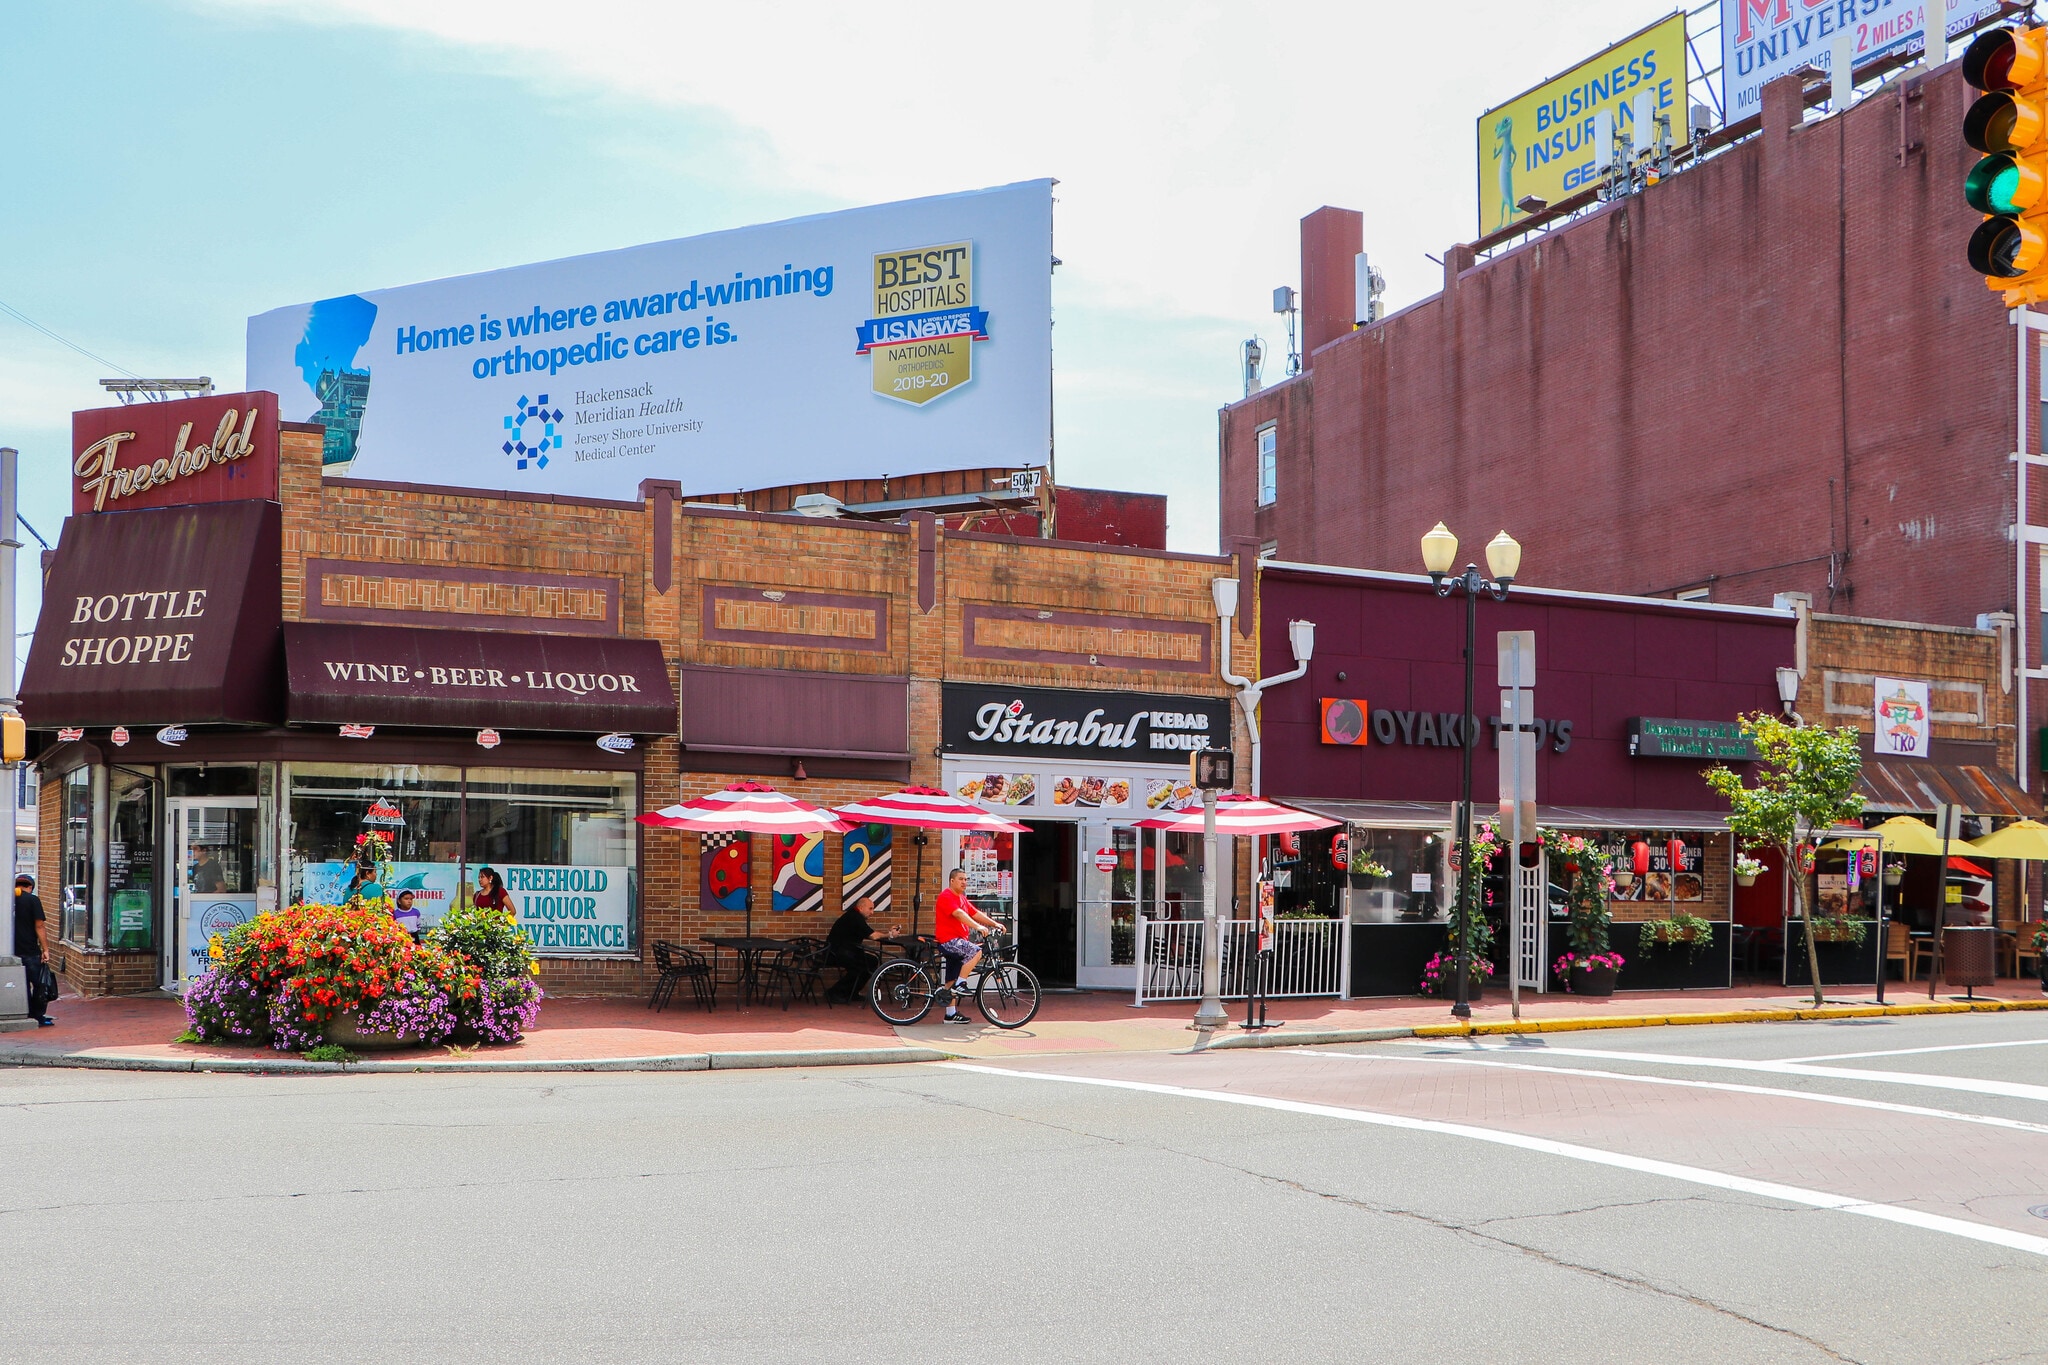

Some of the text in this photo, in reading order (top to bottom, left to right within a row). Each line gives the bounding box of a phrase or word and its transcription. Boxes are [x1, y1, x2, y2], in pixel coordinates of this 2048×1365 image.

[1857, 23, 1868, 53] 2
[1873, 11, 1913, 46] MILES
[1537, 50, 1657, 132] BUSINESS
[1526, 78, 1674, 172] INSURNE
[878, 247, 966, 289] BEST
[396, 264, 835, 354] Home is where award-winning
[878, 282, 966, 314] HOSPITALS
[928, 315, 948, 323] WORLD
[948, 312, 971, 321] REPORT
[472, 316, 738, 379] orthopedic care is.
[888, 342, 954, 362] NATIONAL
[898, 360, 944, 374] ORTHOPEDICS
[575, 382, 654, 405] Hackensack
[893, 372, 949, 392] 2019-20
[575, 397, 683, 425] Meridian Health
[574, 419, 704, 445] Jersey Shore University
[74, 408, 259, 512] Freehold
[574, 443, 656, 462] Medical Center
[70, 589, 207, 624] BOTTLE
[60, 633, 194, 667] SHOPPE
[324, 662, 641, 696] WINE BEER LIQUOR
[1149, 711, 1209, 730] KEBAB
[1372, 708, 1481, 748] OYAKO
[1149, 733, 1210, 751] HOUSE
[1660, 738, 1747, 756] hibachi & sushi
[1891, 733, 1915, 752] TKO
[368, 803, 402, 818] Coors
[373, 830, 395, 842] PEN
[1654, 857, 1670, 870] 30
[507, 868, 608, 892] FREEHOLD
[120, 909, 143, 930] IPA
[523, 896, 597, 922] LIQUOR
